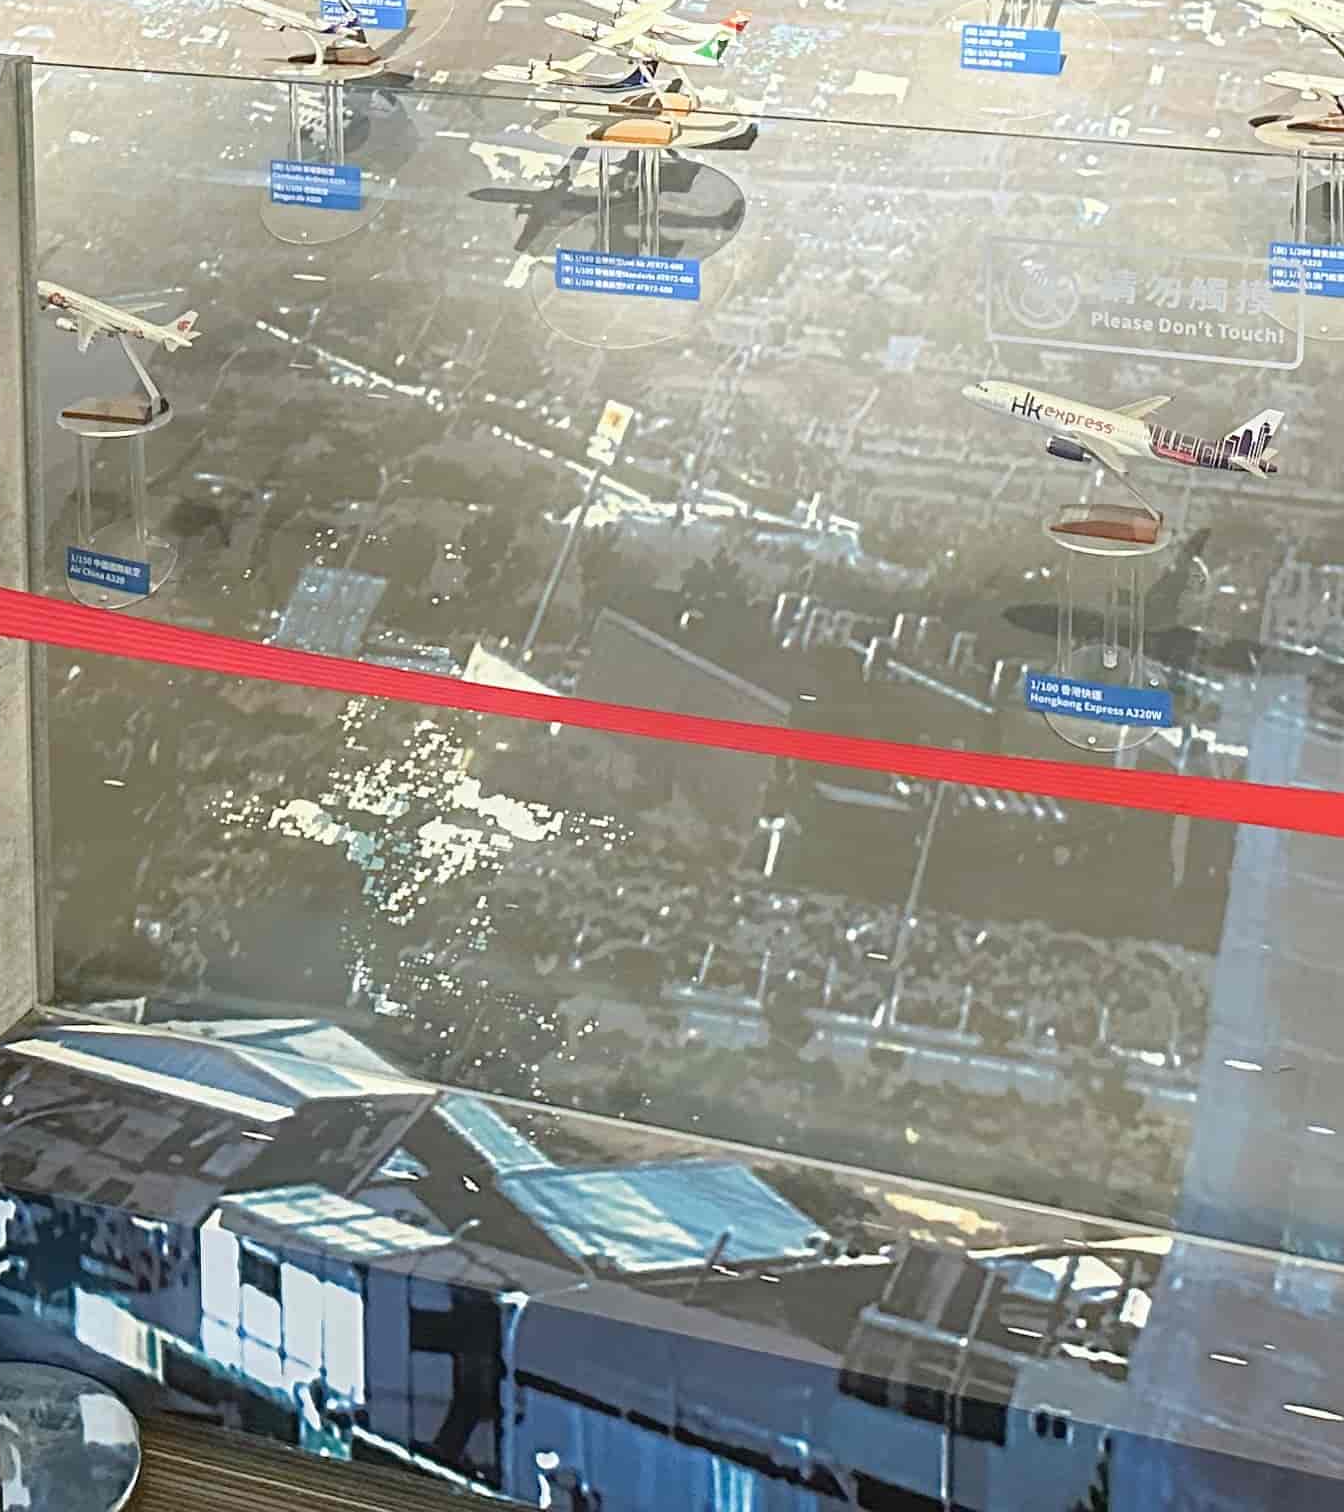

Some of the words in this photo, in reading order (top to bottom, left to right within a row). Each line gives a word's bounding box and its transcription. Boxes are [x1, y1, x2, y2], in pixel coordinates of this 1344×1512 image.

[1101, 268, 1273, 315] 請勿觸摸
[1090, 311, 1154, 333] Please
[1159, 316, 1213, 339] Don't
[1217, 322, 1285, 345] Touch!
[1030, 679, 1059, 693] 1/100
[1030, 692, 1083, 712] Hongkong
[1084, 701, 1124, 717] Express
[1125, 707, 1163, 721] A320W
